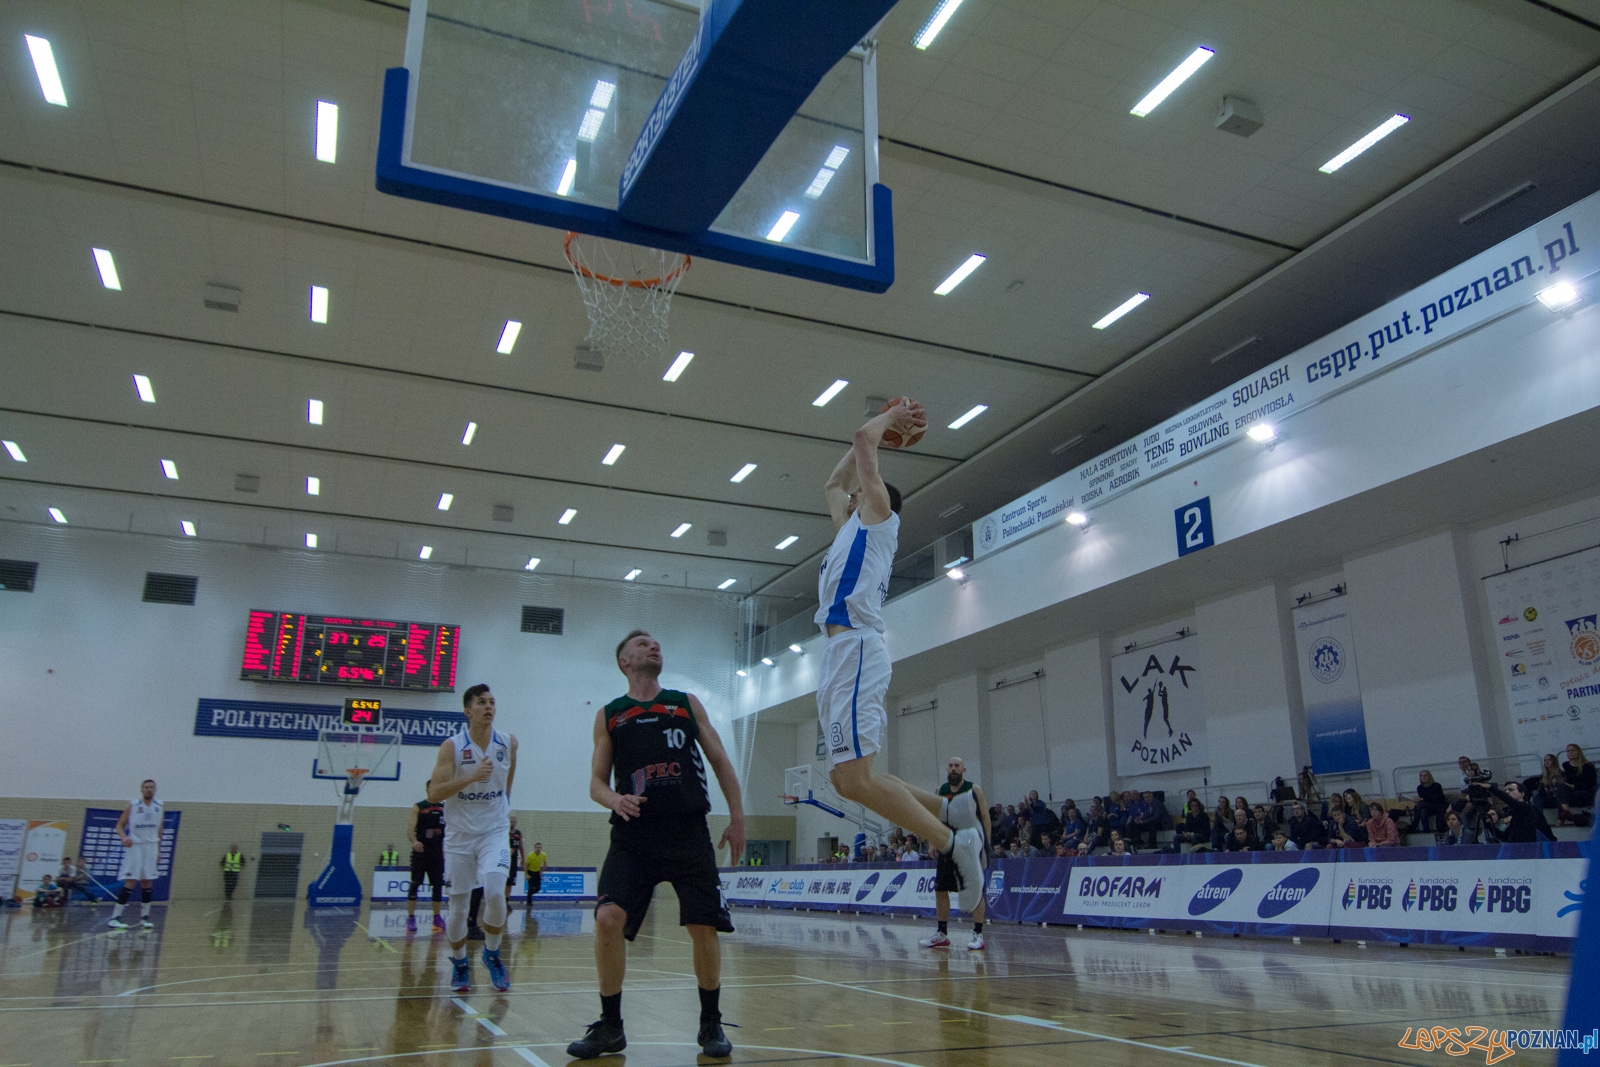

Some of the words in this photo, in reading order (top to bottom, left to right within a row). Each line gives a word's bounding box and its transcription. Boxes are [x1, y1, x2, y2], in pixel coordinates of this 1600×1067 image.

[1306, 221, 1580, 384] cspp.put.poznan.pl
[1232, 364, 1290, 408] SQUASH
[1235, 392, 1295, 430] ERGOWIOSŁA
[1188, 412, 1223, 436] SIŁOWNIA
[1143, 432, 1160, 448] JUDO
[1144, 438, 1175, 463] TENIS
[1179, 421, 1230, 457] BOWLING
[1080, 464, 1099, 481] HALA
[1100, 443, 1138, 470] SPORTOWA
[1120, 457, 1138, 471] SZACHY
[1151, 457, 1168, 470] KARATE
[1109, 467, 1140, 491] AEROBIK
[1081, 487, 1103, 504] BOISKA
[1001, 506, 1027, 524] Centrum
[1027, 495, 1048, 512] Sportu
[1002, 516, 1036, 539] Politechniki
[1037, 496, 1075, 523] Poznańskiej
[1183, 506, 1204, 549] 2
[328, 632, 348, 645] 37
[351, 709, 372, 723] 24
[662, 728, 686, 749] 10
[830, 722, 844, 747] 8
[1131, 732, 1193, 764] POZNAŃ
[916, 876, 937, 893] BIO
[1010, 885, 1061, 895] www.basket.poznan.pl
[1197, 884, 1231, 900] atrem
[1267, 884, 1306, 901] atrem
[1358, 877, 1393, 885] fundacja
[1420, 877, 1459, 885] fundacja
[1488, 876, 1532, 885] fundacja
[1133, 901, 1152, 909] LEKÓW
[1356, 885, 1392, 910] PBG
[1418, 885, 1458, 911] PBG
[1487, 885, 1531, 913] PBG
